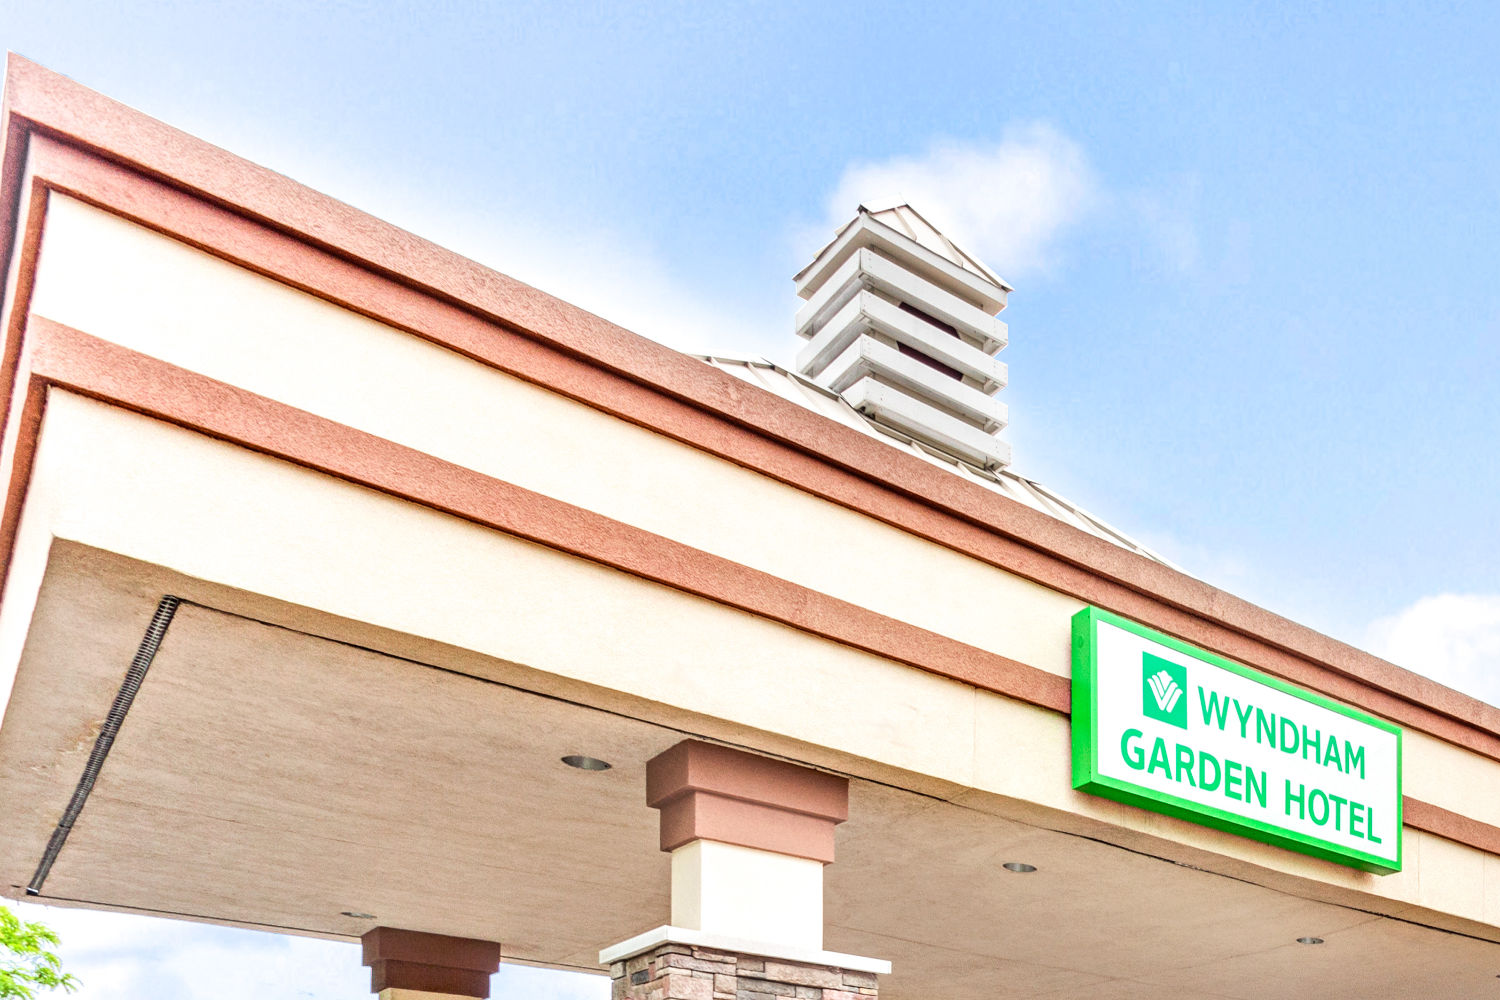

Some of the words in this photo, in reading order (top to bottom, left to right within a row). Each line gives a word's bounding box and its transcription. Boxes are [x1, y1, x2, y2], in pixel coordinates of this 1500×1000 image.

[1197, 685, 1366, 780] WYNDHAM
[1120, 728, 1267, 809] GARDEN
[1284, 778, 1383, 845] HOTEL
